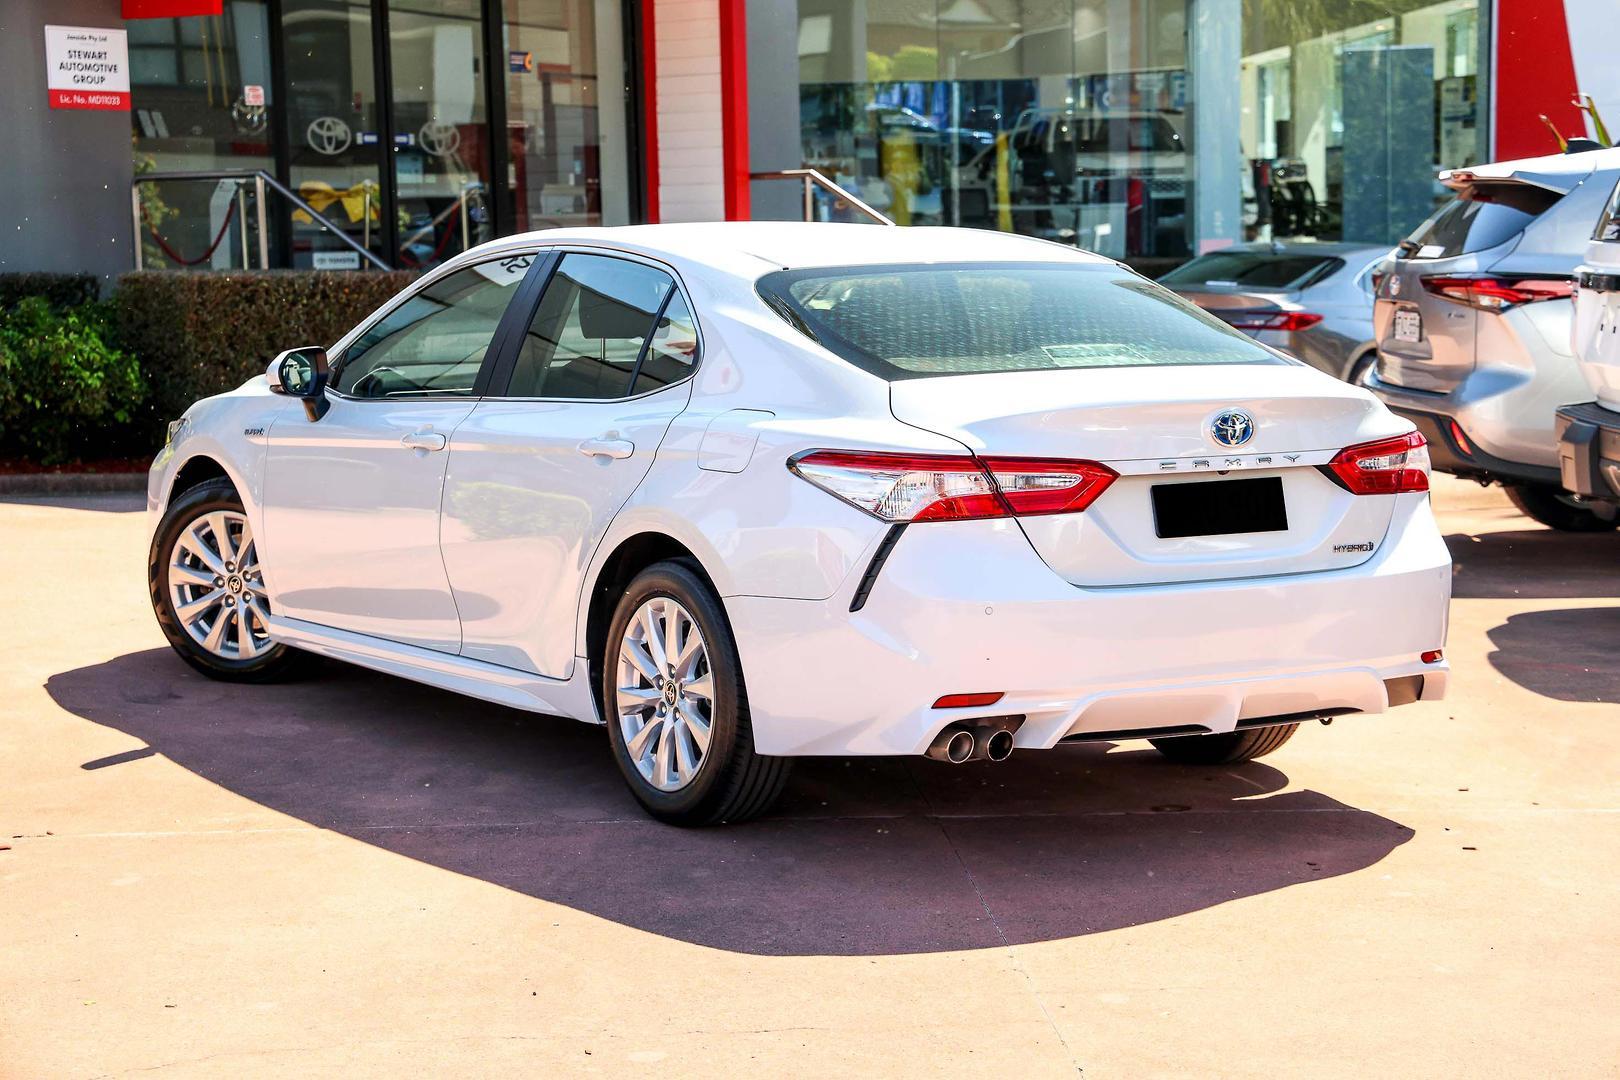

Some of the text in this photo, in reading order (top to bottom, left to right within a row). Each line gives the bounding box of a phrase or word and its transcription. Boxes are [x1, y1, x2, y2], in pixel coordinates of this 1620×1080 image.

[68, 50, 107, 60] STEWART
[59, 62, 118, 73] AUTOMOTIVE
[73, 74, 105, 84] GROUP
[1333, 544, 1368, 553] HYBRID
